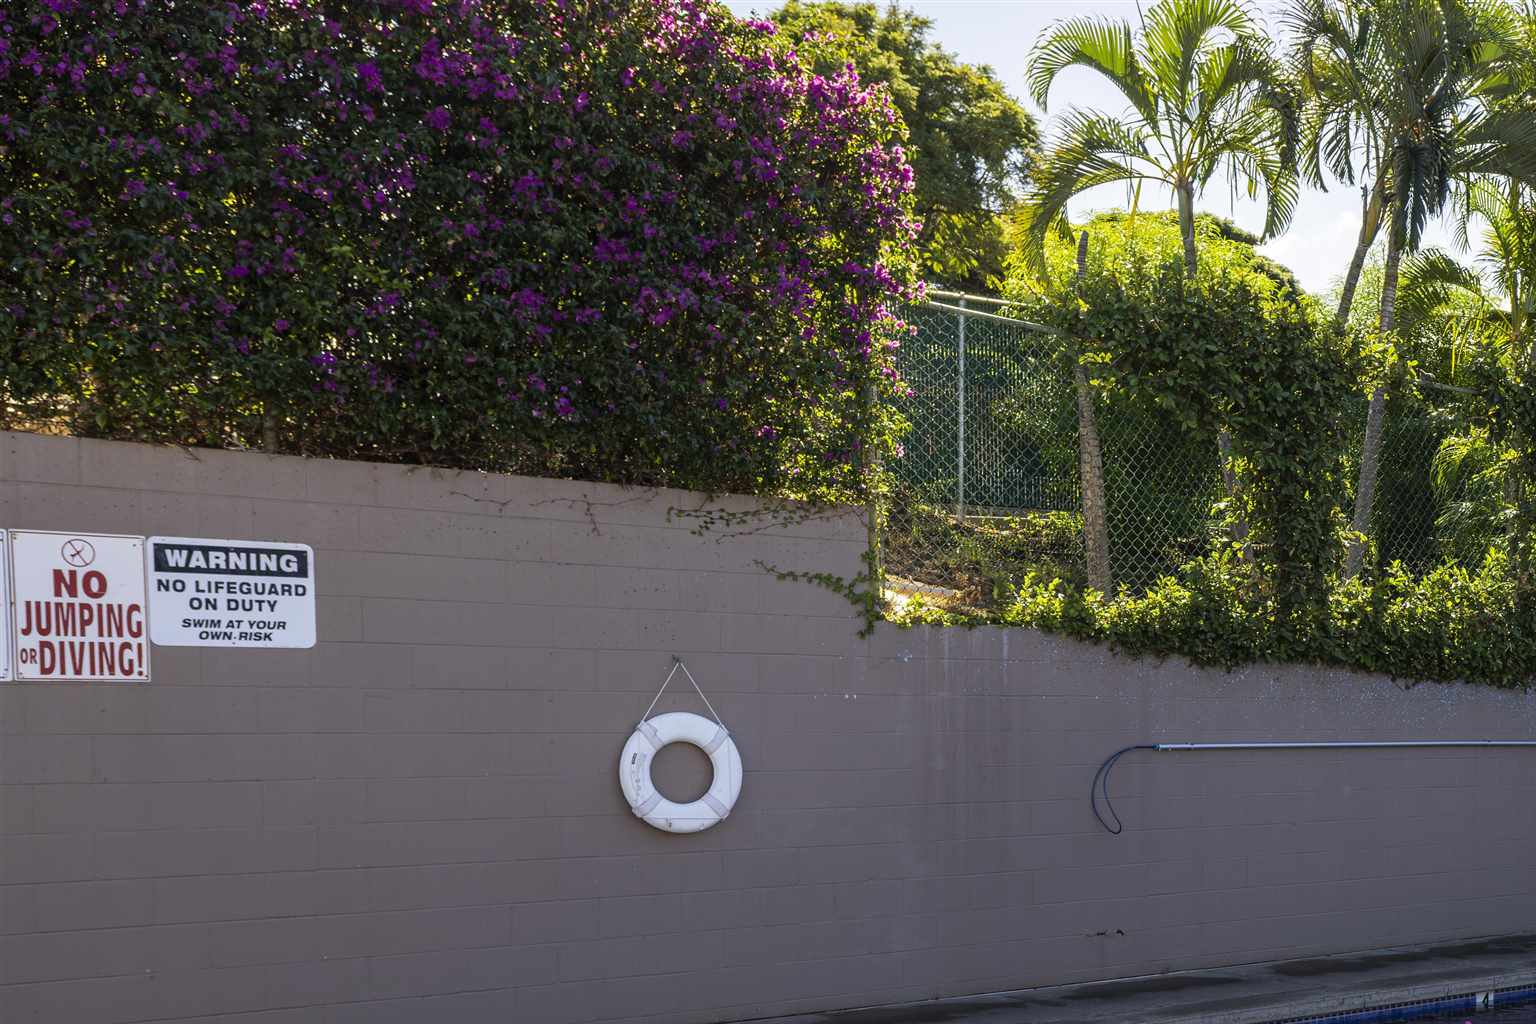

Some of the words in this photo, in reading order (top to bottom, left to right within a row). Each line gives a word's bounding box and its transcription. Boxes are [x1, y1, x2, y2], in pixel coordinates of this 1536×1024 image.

[164, 549, 299, 573] WARNING
[53, 569, 108, 599] NO
[157, 579, 186, 593] NO
[195, 580, 307, 597] LIFEGUARD
[189, 597, 218, 611] ON
[227, 599, 278, 612] DUTY
[21, 600, 143, 638] JUMPING
[181, 618, 222, 629] SWIM
[225, 620, 243, 629] AT
[248, 620, 287, 630] YOUR
[199, 631, 232, 641] OWN
[238, 632, 273, 642] RISK
[20, 647, 38, 664] OR
[39, 640, 144, 677] DIVING!
